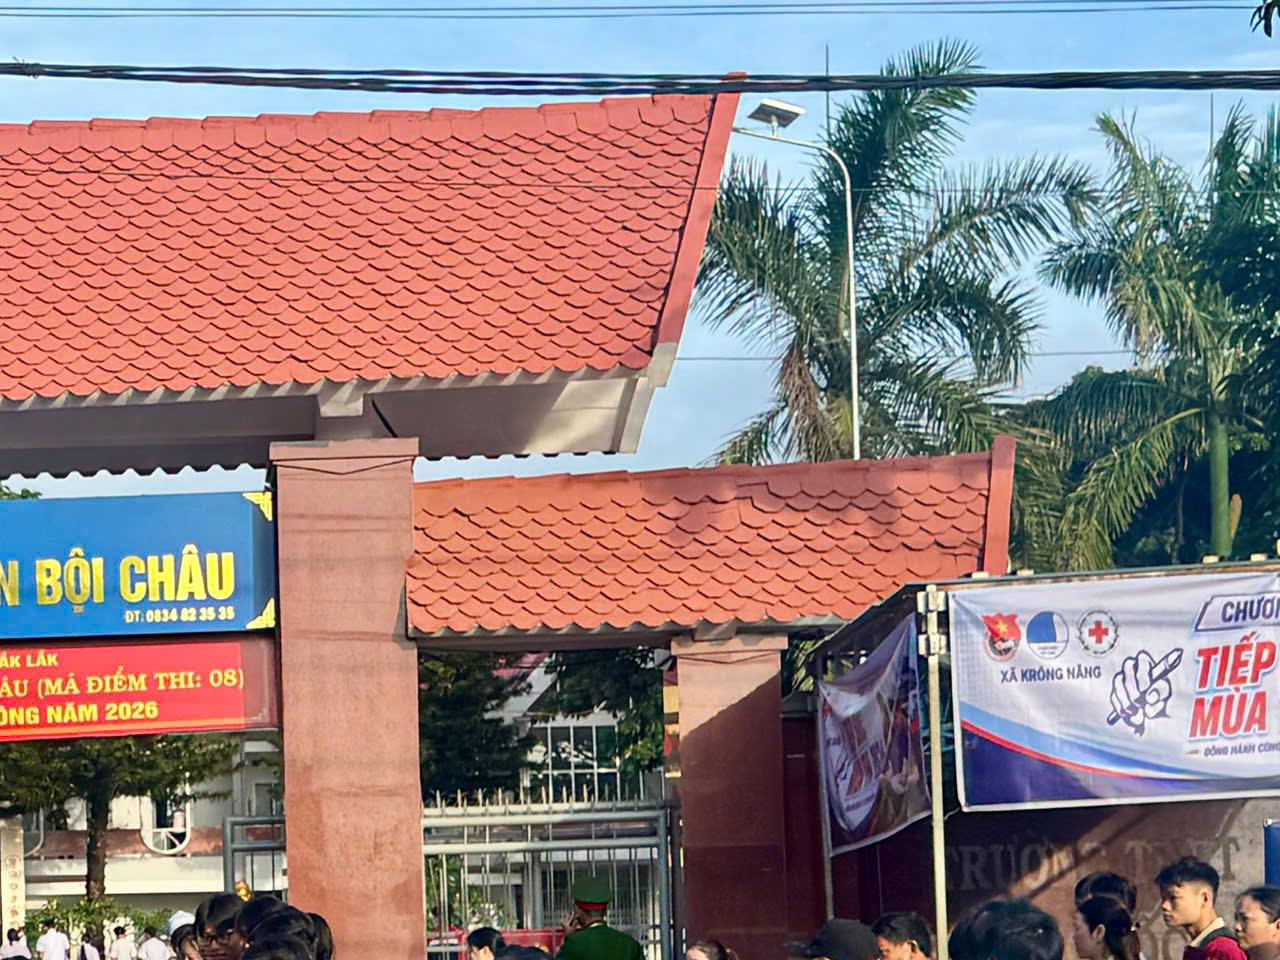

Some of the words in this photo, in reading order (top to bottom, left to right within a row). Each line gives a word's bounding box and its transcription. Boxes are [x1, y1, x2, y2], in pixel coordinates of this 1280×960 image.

[35, 547, 105, 614] BỘI
[119, 543, 235, 603] CHÂU
[1221, 595, 1280, 623] CHƯƠ
[1000, 667, 1018, 684] XÃ
[1020, 665, 1064, 682] KRÔNG
[1066, 663, 1102, 680] NĂNG
[1197, 631, 1277, 690] TIẾP
[37, 673, 80, 699] (MÃ
[86, 665, 147, 694] ĐIỂM
[153, 670, 201, 691] THI:
[208, 668, 244, 690] 08)
[46, 702, 98, 724] NĂM
[105, 701, 159, 721] 2026
[1188, 686, 1267, 738] MÙA
